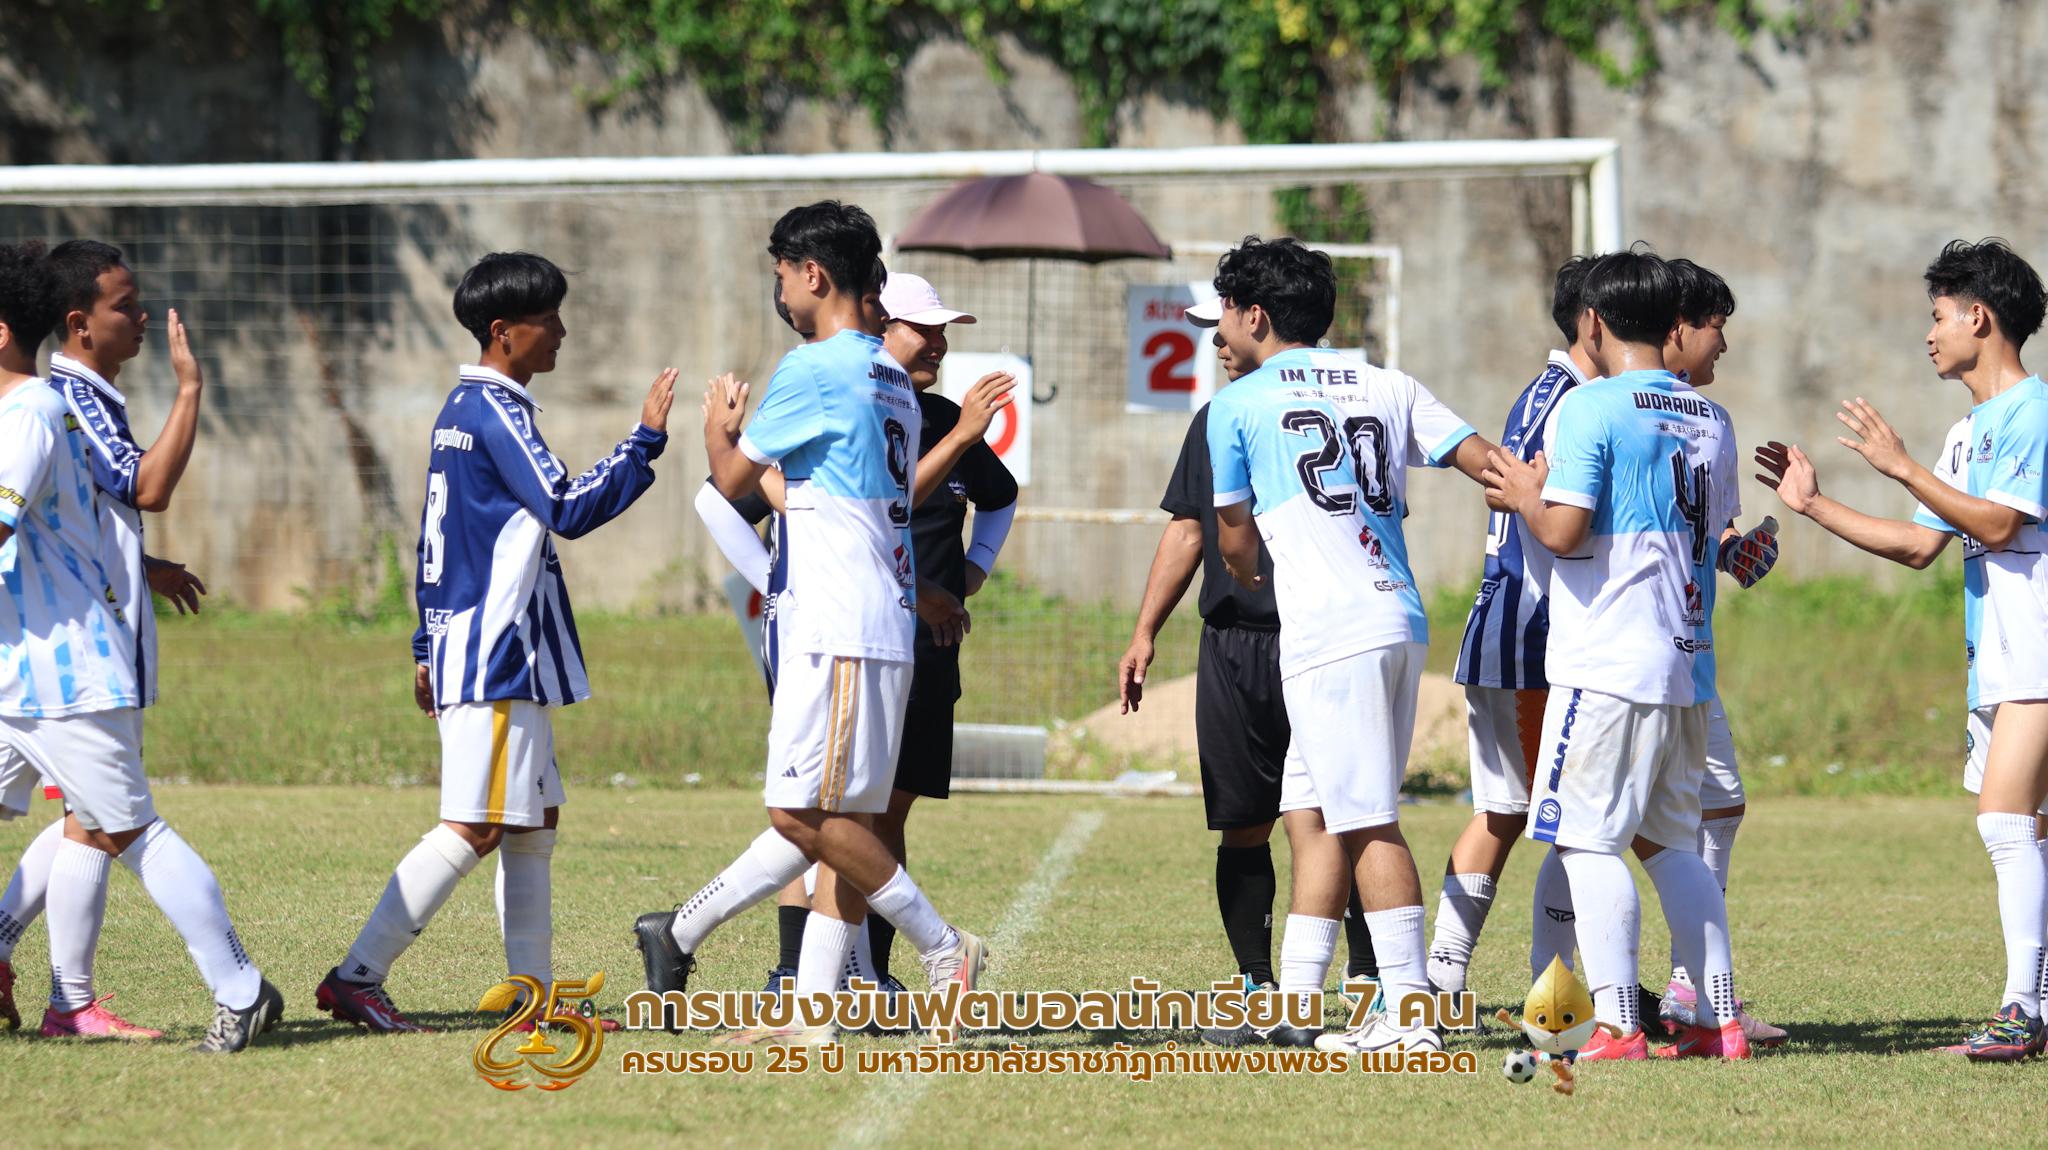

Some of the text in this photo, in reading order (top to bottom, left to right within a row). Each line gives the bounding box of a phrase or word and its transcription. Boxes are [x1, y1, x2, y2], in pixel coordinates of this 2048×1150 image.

[1143, 331, 1197, 393] 2
[1280, 368, 1358, 385] IM TEE
[1281, 409, 1394, 517] 20
[1669, 446, 1712, 567] 4
[1548, 742, 1569, 793] BEAR
